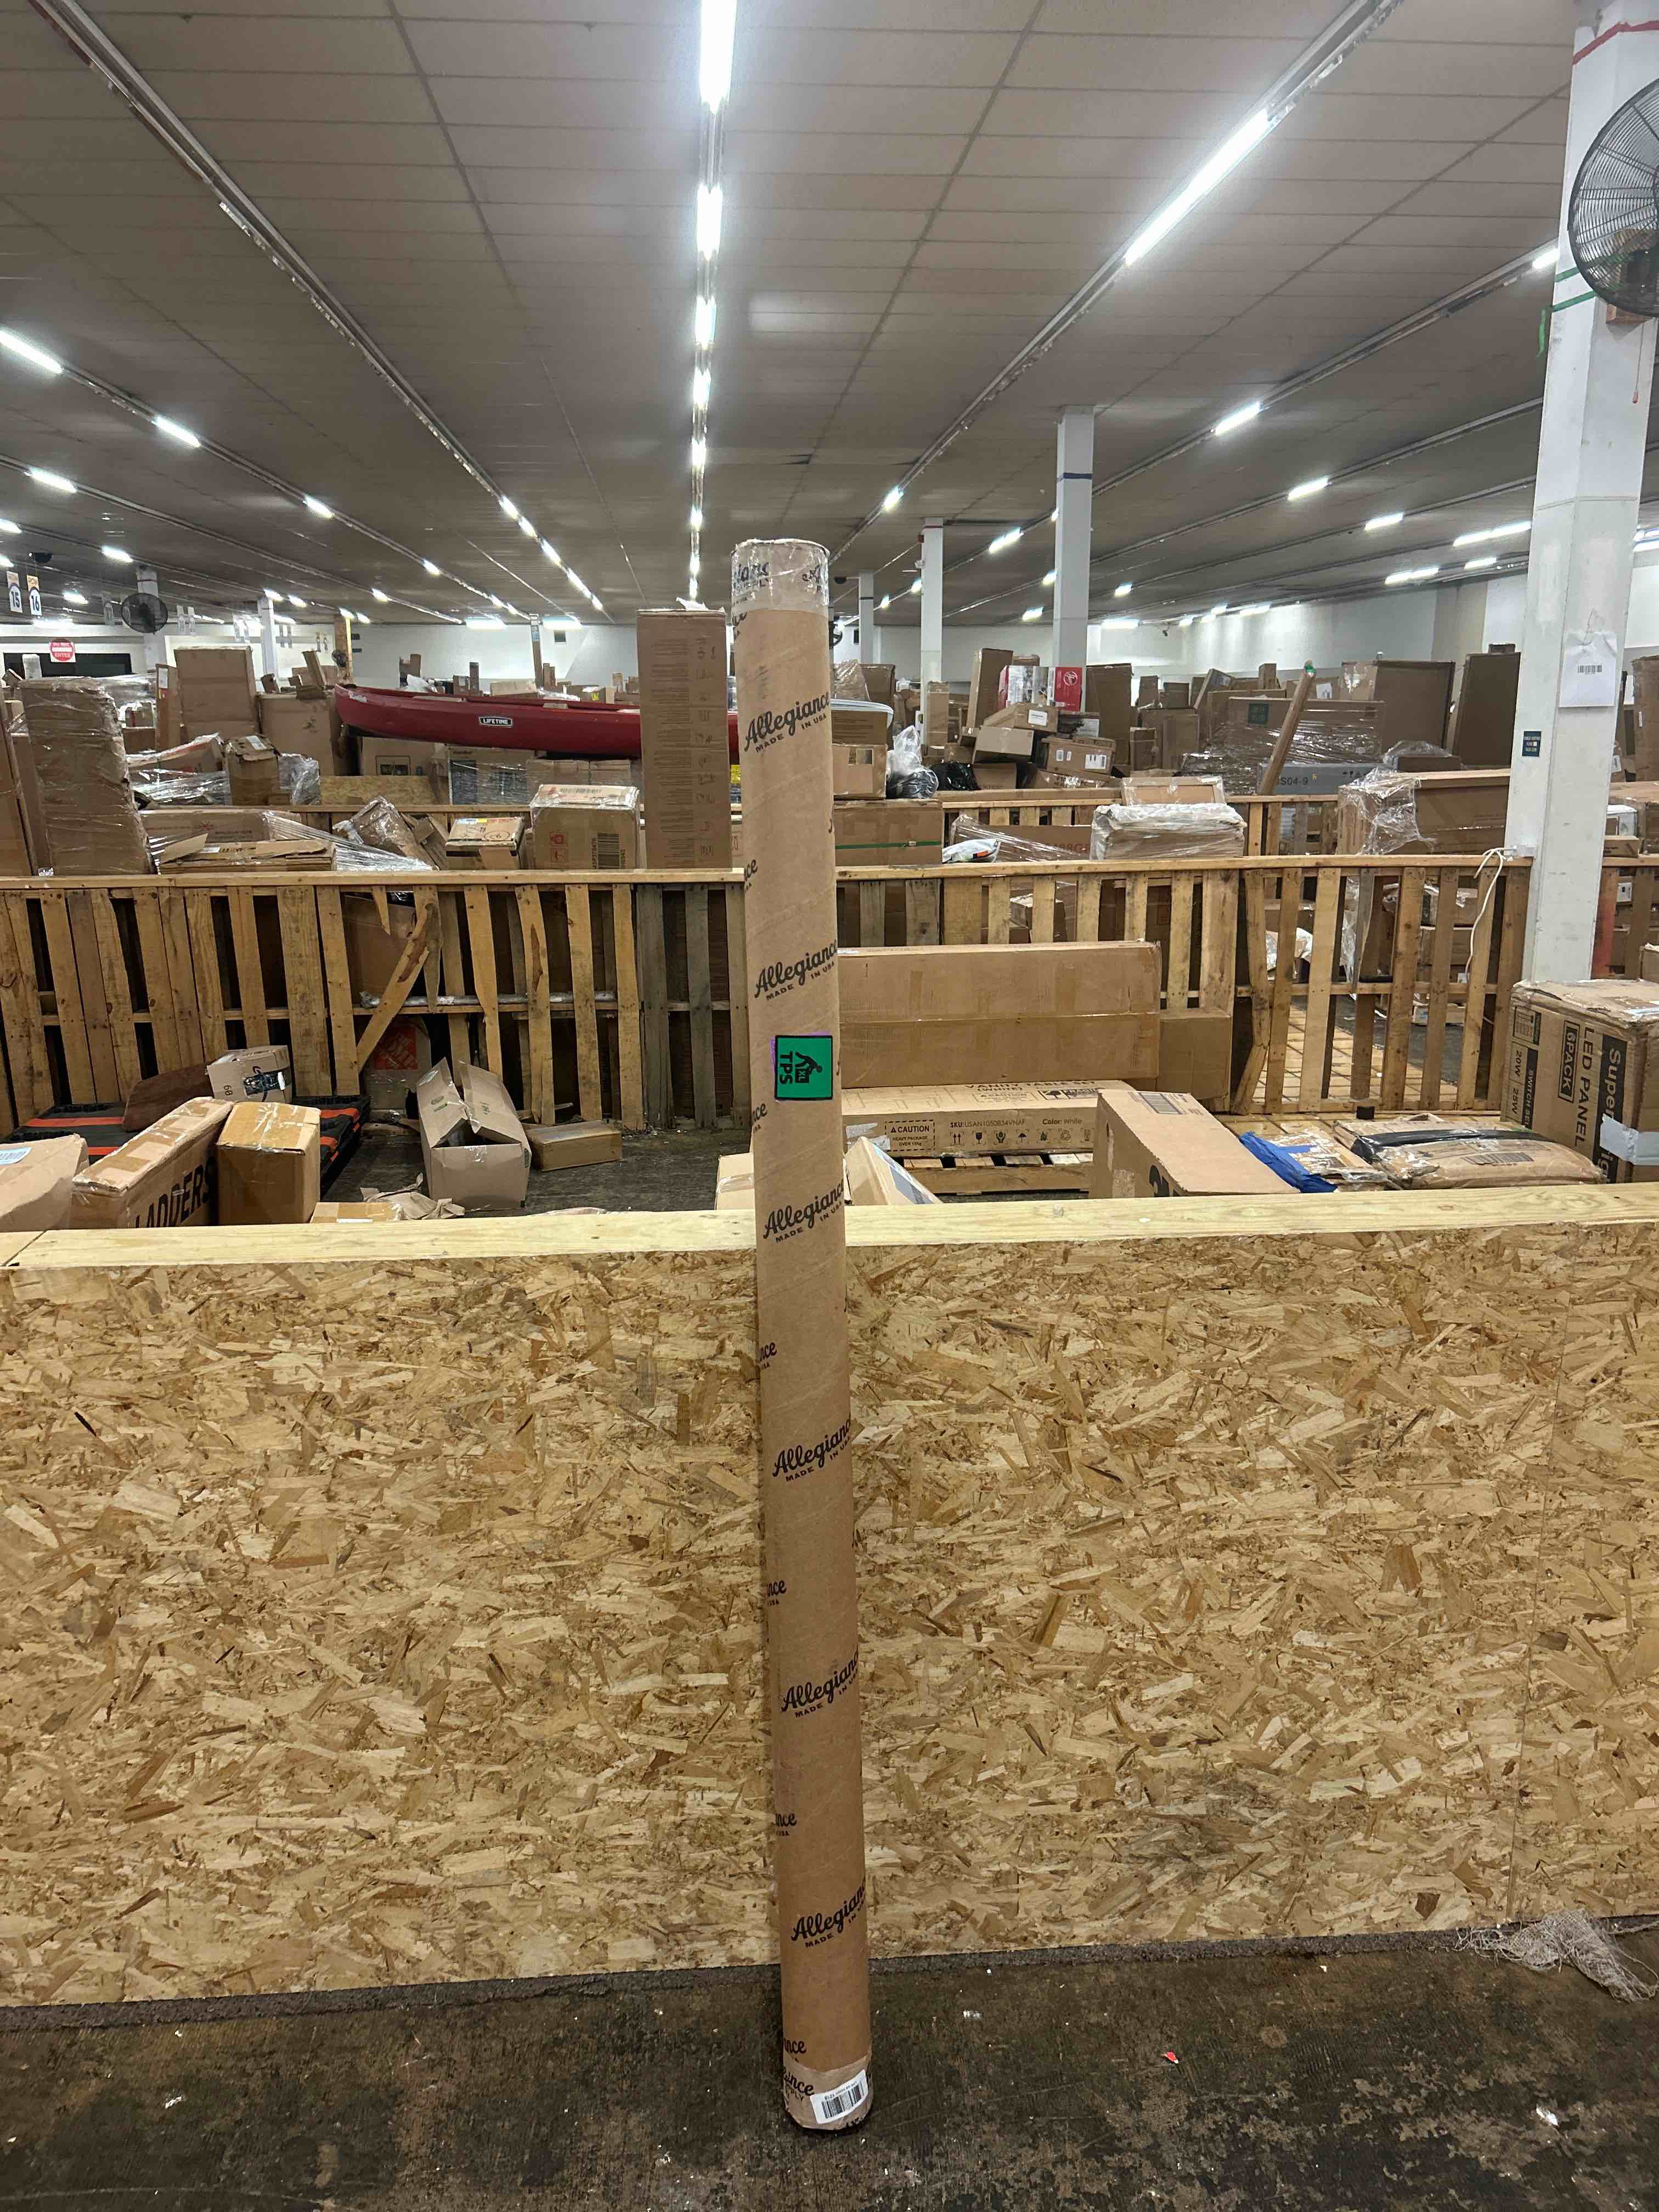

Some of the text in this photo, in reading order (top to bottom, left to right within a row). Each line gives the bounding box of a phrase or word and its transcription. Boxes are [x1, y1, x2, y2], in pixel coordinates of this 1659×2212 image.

[11, 591, 20, 608] 15
[31, 595, 40, 611] 16
[755, 733, 785, 753] MADE
[800, 721, 811, 730] IN
[766, 984, 795, 1001] MADE
[810, 970, 821, 979] IN
[780, 1051, 793, 1085] TPS
[798, 1069, 806, 1082] XL
[1514, 1049, 1522, 1077] 20W
[1562, 1031, 1577, 1091] 6PACK
[1525, 1069, 1534, 1108] SWITCH
[1575, 1027, 1595, 1147] LED PANEL
[775, 1227, 804, 1243] MADE
[820, 1212, 830, 1222] IN
[786, 1466, 814, 1482] MADE
[829, 1452, 839, 1460] IN
[795, 1685, 848, 1718] MADE IN
[805, 1913, 856, 1948] MADE IN
